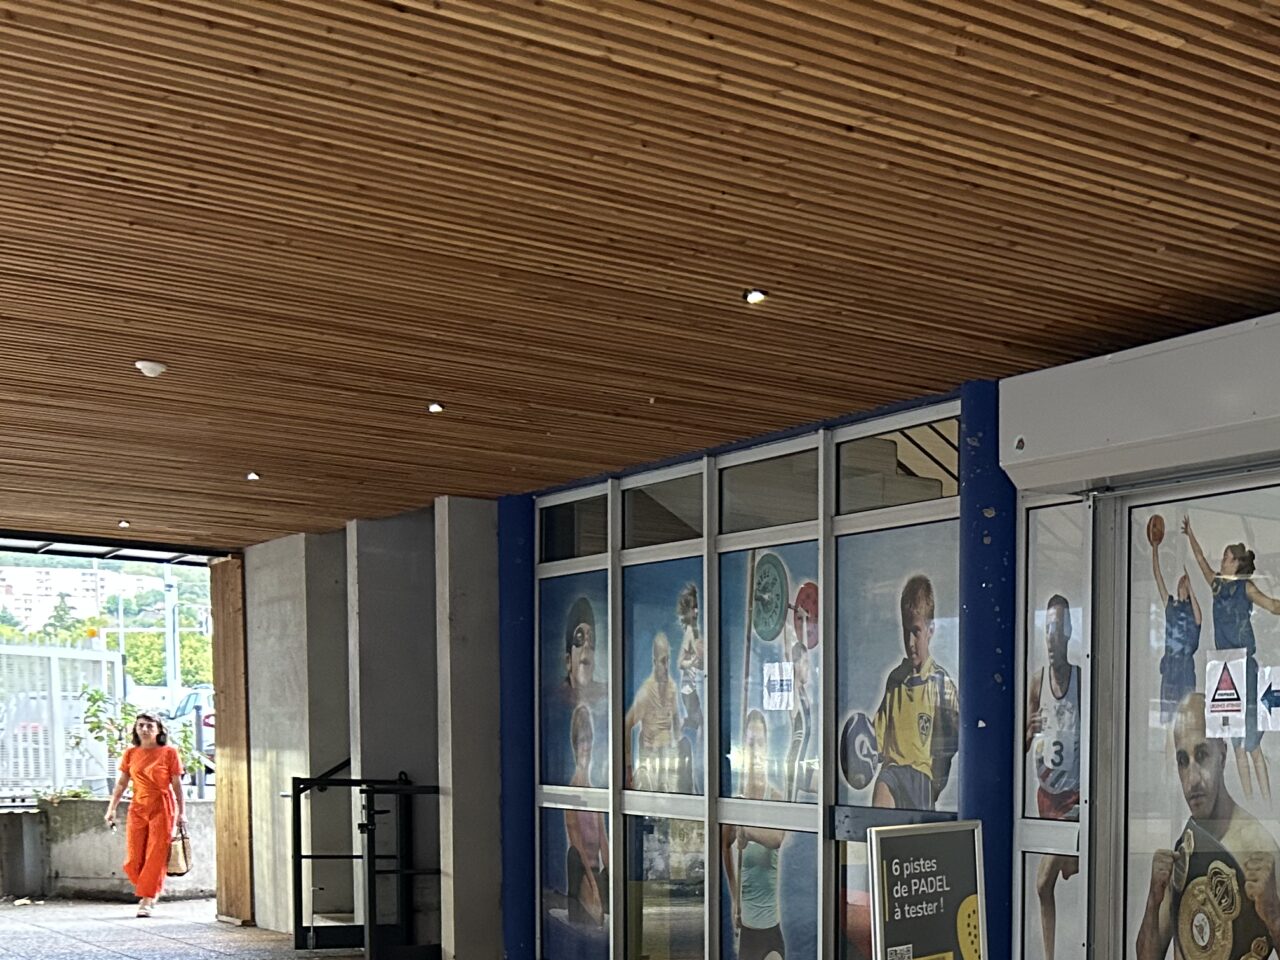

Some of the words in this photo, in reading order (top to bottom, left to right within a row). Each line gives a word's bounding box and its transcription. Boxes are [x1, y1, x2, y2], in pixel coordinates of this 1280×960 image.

[1050, 740, 1064, 768] 3
[892, 859, 901, 876] 6
[903, 857, 938, 879] pistes
[893, 880, 910, 899] de
[911, 875, 951, 897] PADEL
[894, 902, 902, 920] à
[904, 901, 939, 919] tester
[940, 896, 945, 913] !
